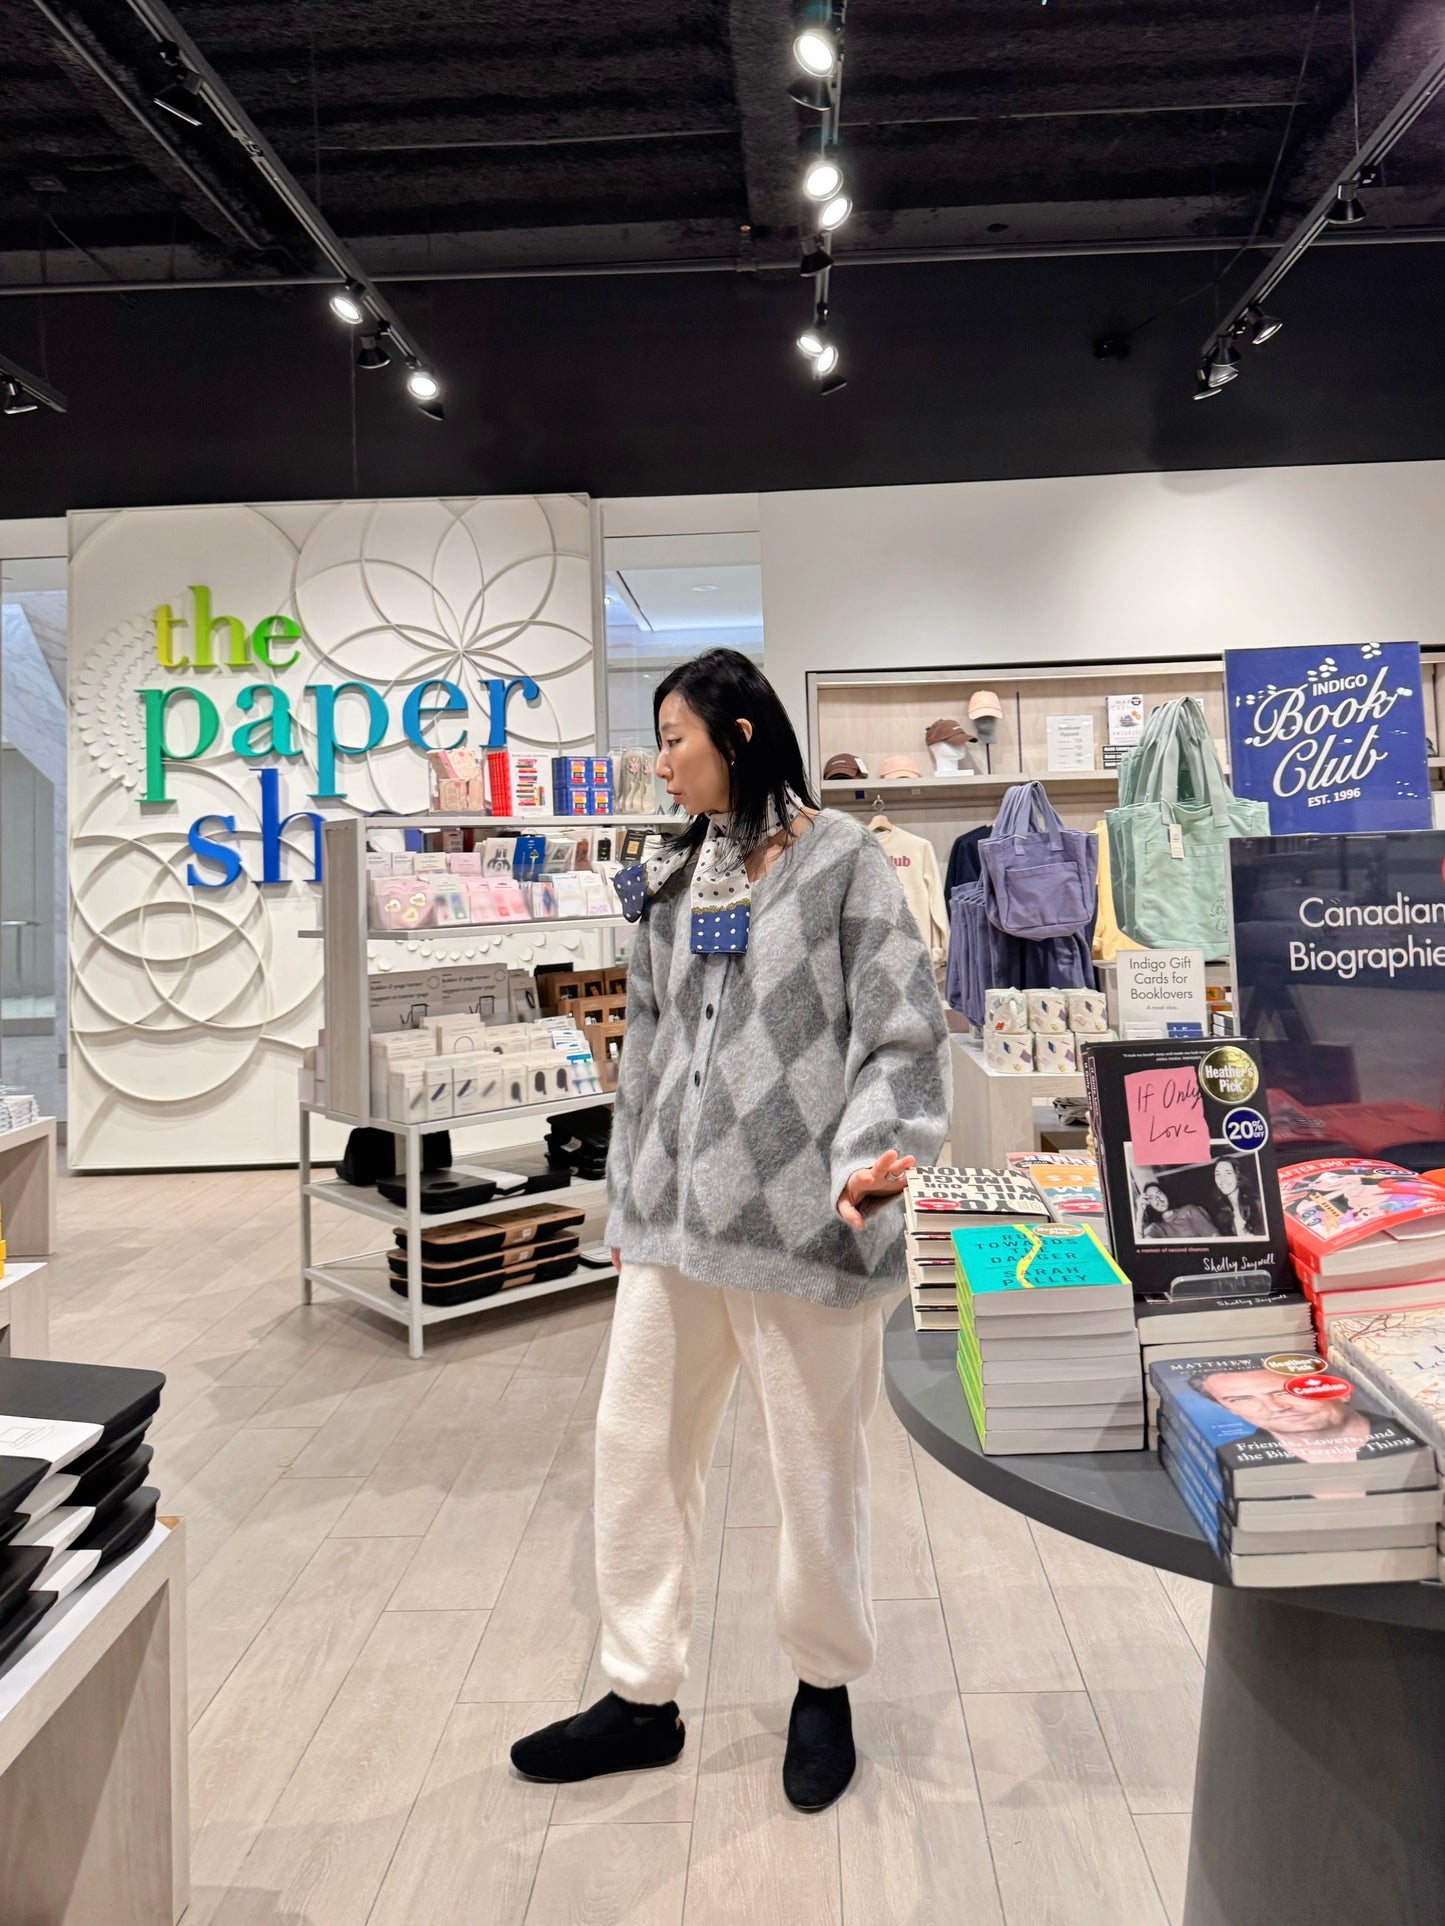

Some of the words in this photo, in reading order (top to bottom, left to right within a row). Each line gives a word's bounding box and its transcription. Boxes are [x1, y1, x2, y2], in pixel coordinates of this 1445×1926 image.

[151, 584, 302, 670] the
[1312, 673, 1368, 696] INDIGO
[1252, 666, 1400, 747] Book
[134, 676, 540, 802] paper
[1272, 724, 1388, 797] Club
[1308, 794, 1332, 808] EST.
[1334, 787, 1362, 803] 1996
[187, 768, 322, 889] sh
[889, 855, 912, 867] lub
[1299, 891, 1445, 929] Canadian
[1129, 957, 1167, 972] Indigo
[1169, 956, 1192, 969] Gift
[1134, 972, 1169, 985] Cards
[1172, 971, 1188, 984] for
[1130, 987, 1194, 1000] Booklovers
[1205, 1064, 1254, 1080] Heather's
[1219, 1079, 1244, 1093] Pick
[1137, 1083, 1154, 1113] If
[1163, 1079, 1202, 1110] Only
[1149, 1115, 1197, 1142] Love
[1279, 1163, 1319, 1180] AFTER
[913, 1191, 967, 1199] NOT
[968, 1184, 1036, 1194] KILL
[975, 1192, 1042, 1201] WILL
[961, 1199, 1014, 1211] YO
[975, 1238, 1078, 1250] TOWARDS
[991, 1252, 1078, 1264] DANGER
[1203, 1256, 1238, 1272] Shelley
[1004, 1266, 1079, 1278] SARAH
[1169, 1359, 1252, 1371] MATTHEW
[1267, 1357, 1322, 1370] Heather's
[1287, 1361, 1315, 1372] Pick
[1293, 1383, 1347, 1396] Canadian
[1365, 1428, 1396, 1440] and
[1236, 1450, 1264, 1463] the
[1267, 1447, 1294, 1462] Big
[1366, 1436, 1415, 1453] Thing
